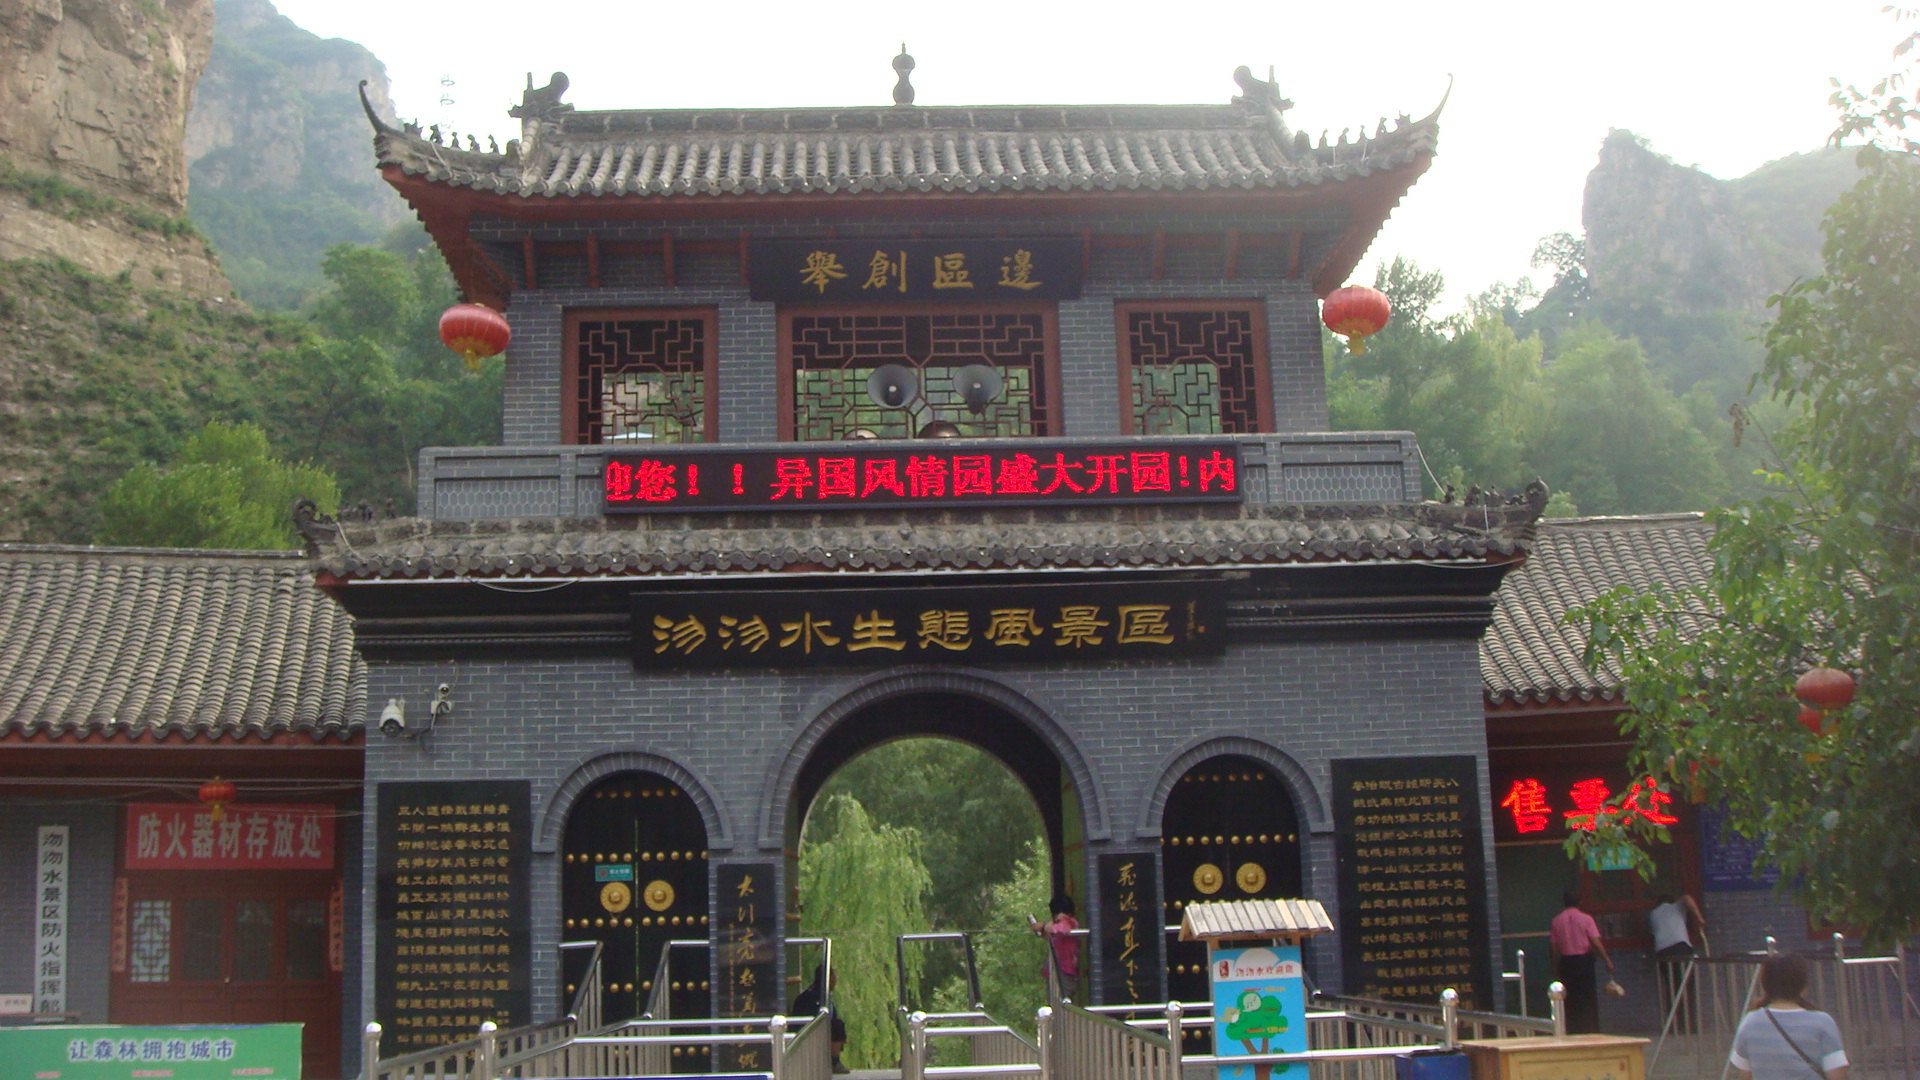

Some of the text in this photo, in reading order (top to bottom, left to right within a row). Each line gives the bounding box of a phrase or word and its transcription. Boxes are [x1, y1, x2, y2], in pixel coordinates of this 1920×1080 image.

[137, 812, 322, 860] 防火器材存放处
[68, 1038, 237, 1062] 让森林拥抱城市
